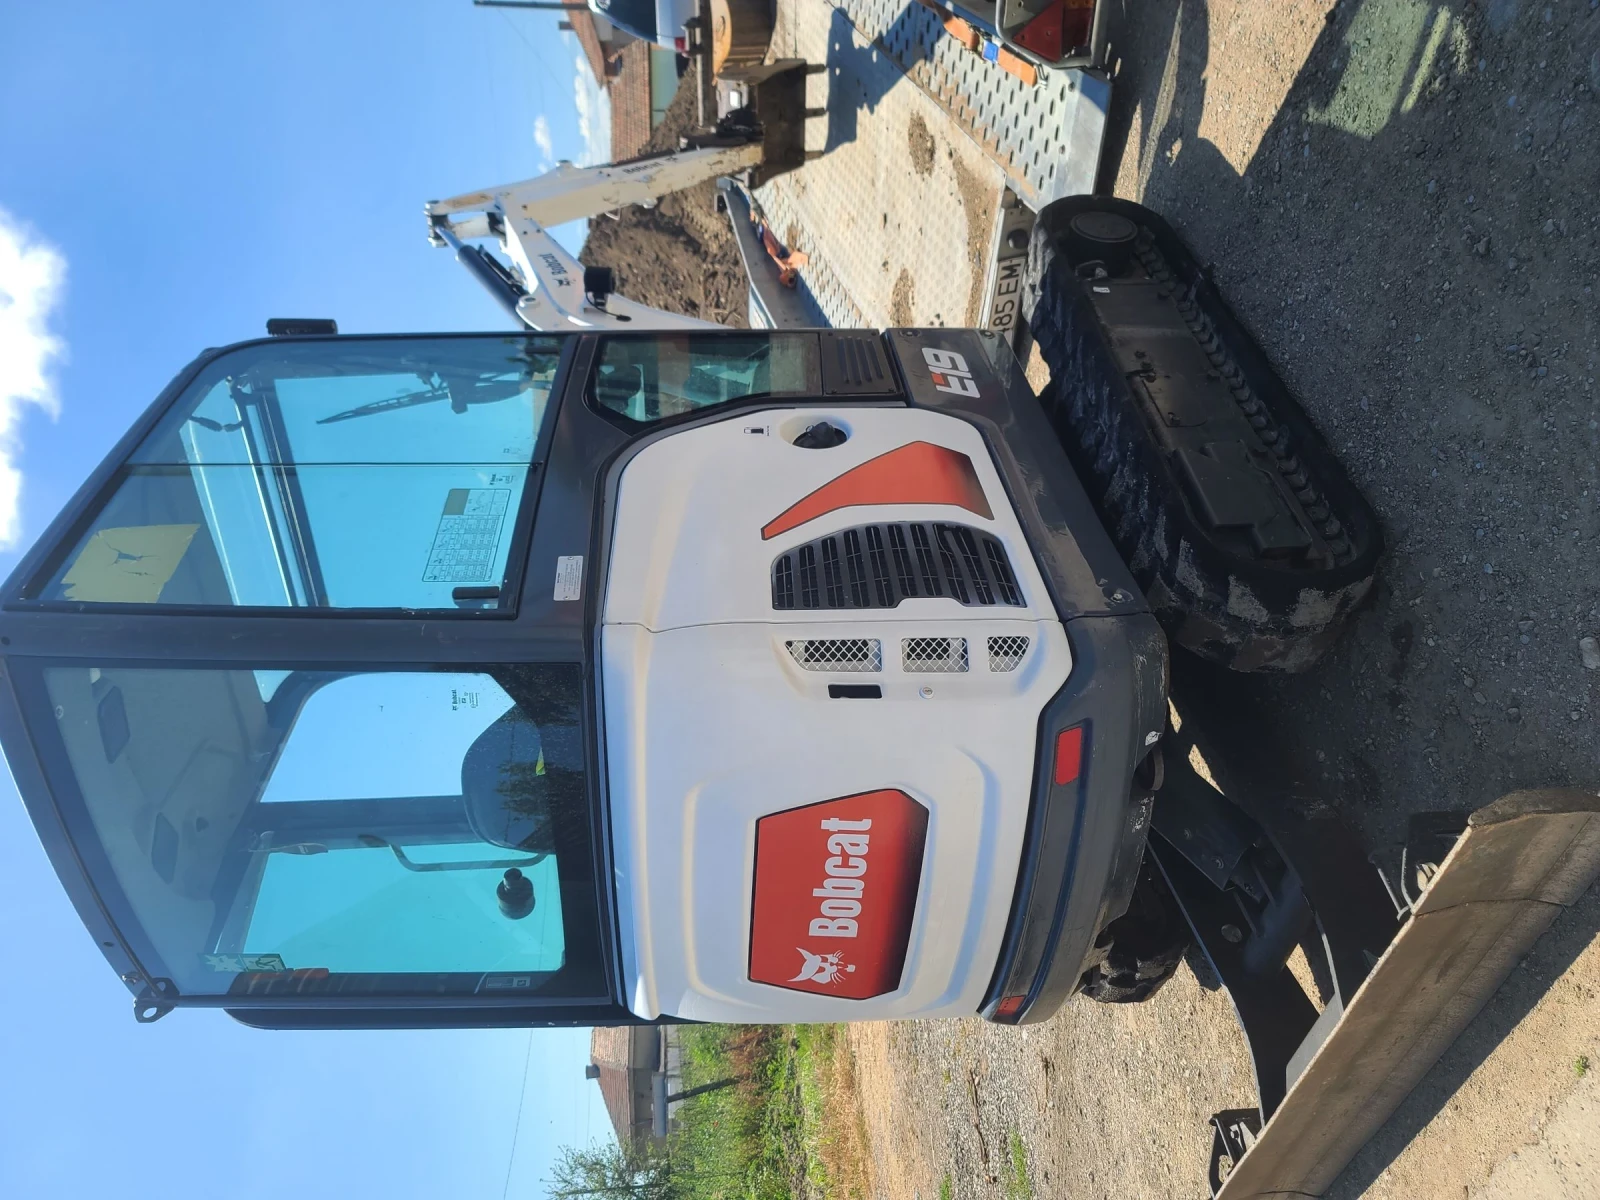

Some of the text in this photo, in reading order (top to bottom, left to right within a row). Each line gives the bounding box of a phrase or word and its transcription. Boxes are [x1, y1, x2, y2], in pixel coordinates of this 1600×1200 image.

[537, 253, 568, 275] Bobcat
[998, 263, 1021, 296] EM
[921, 347, 980, 398] E19
[808, 817, 872, 938] Bobcat
